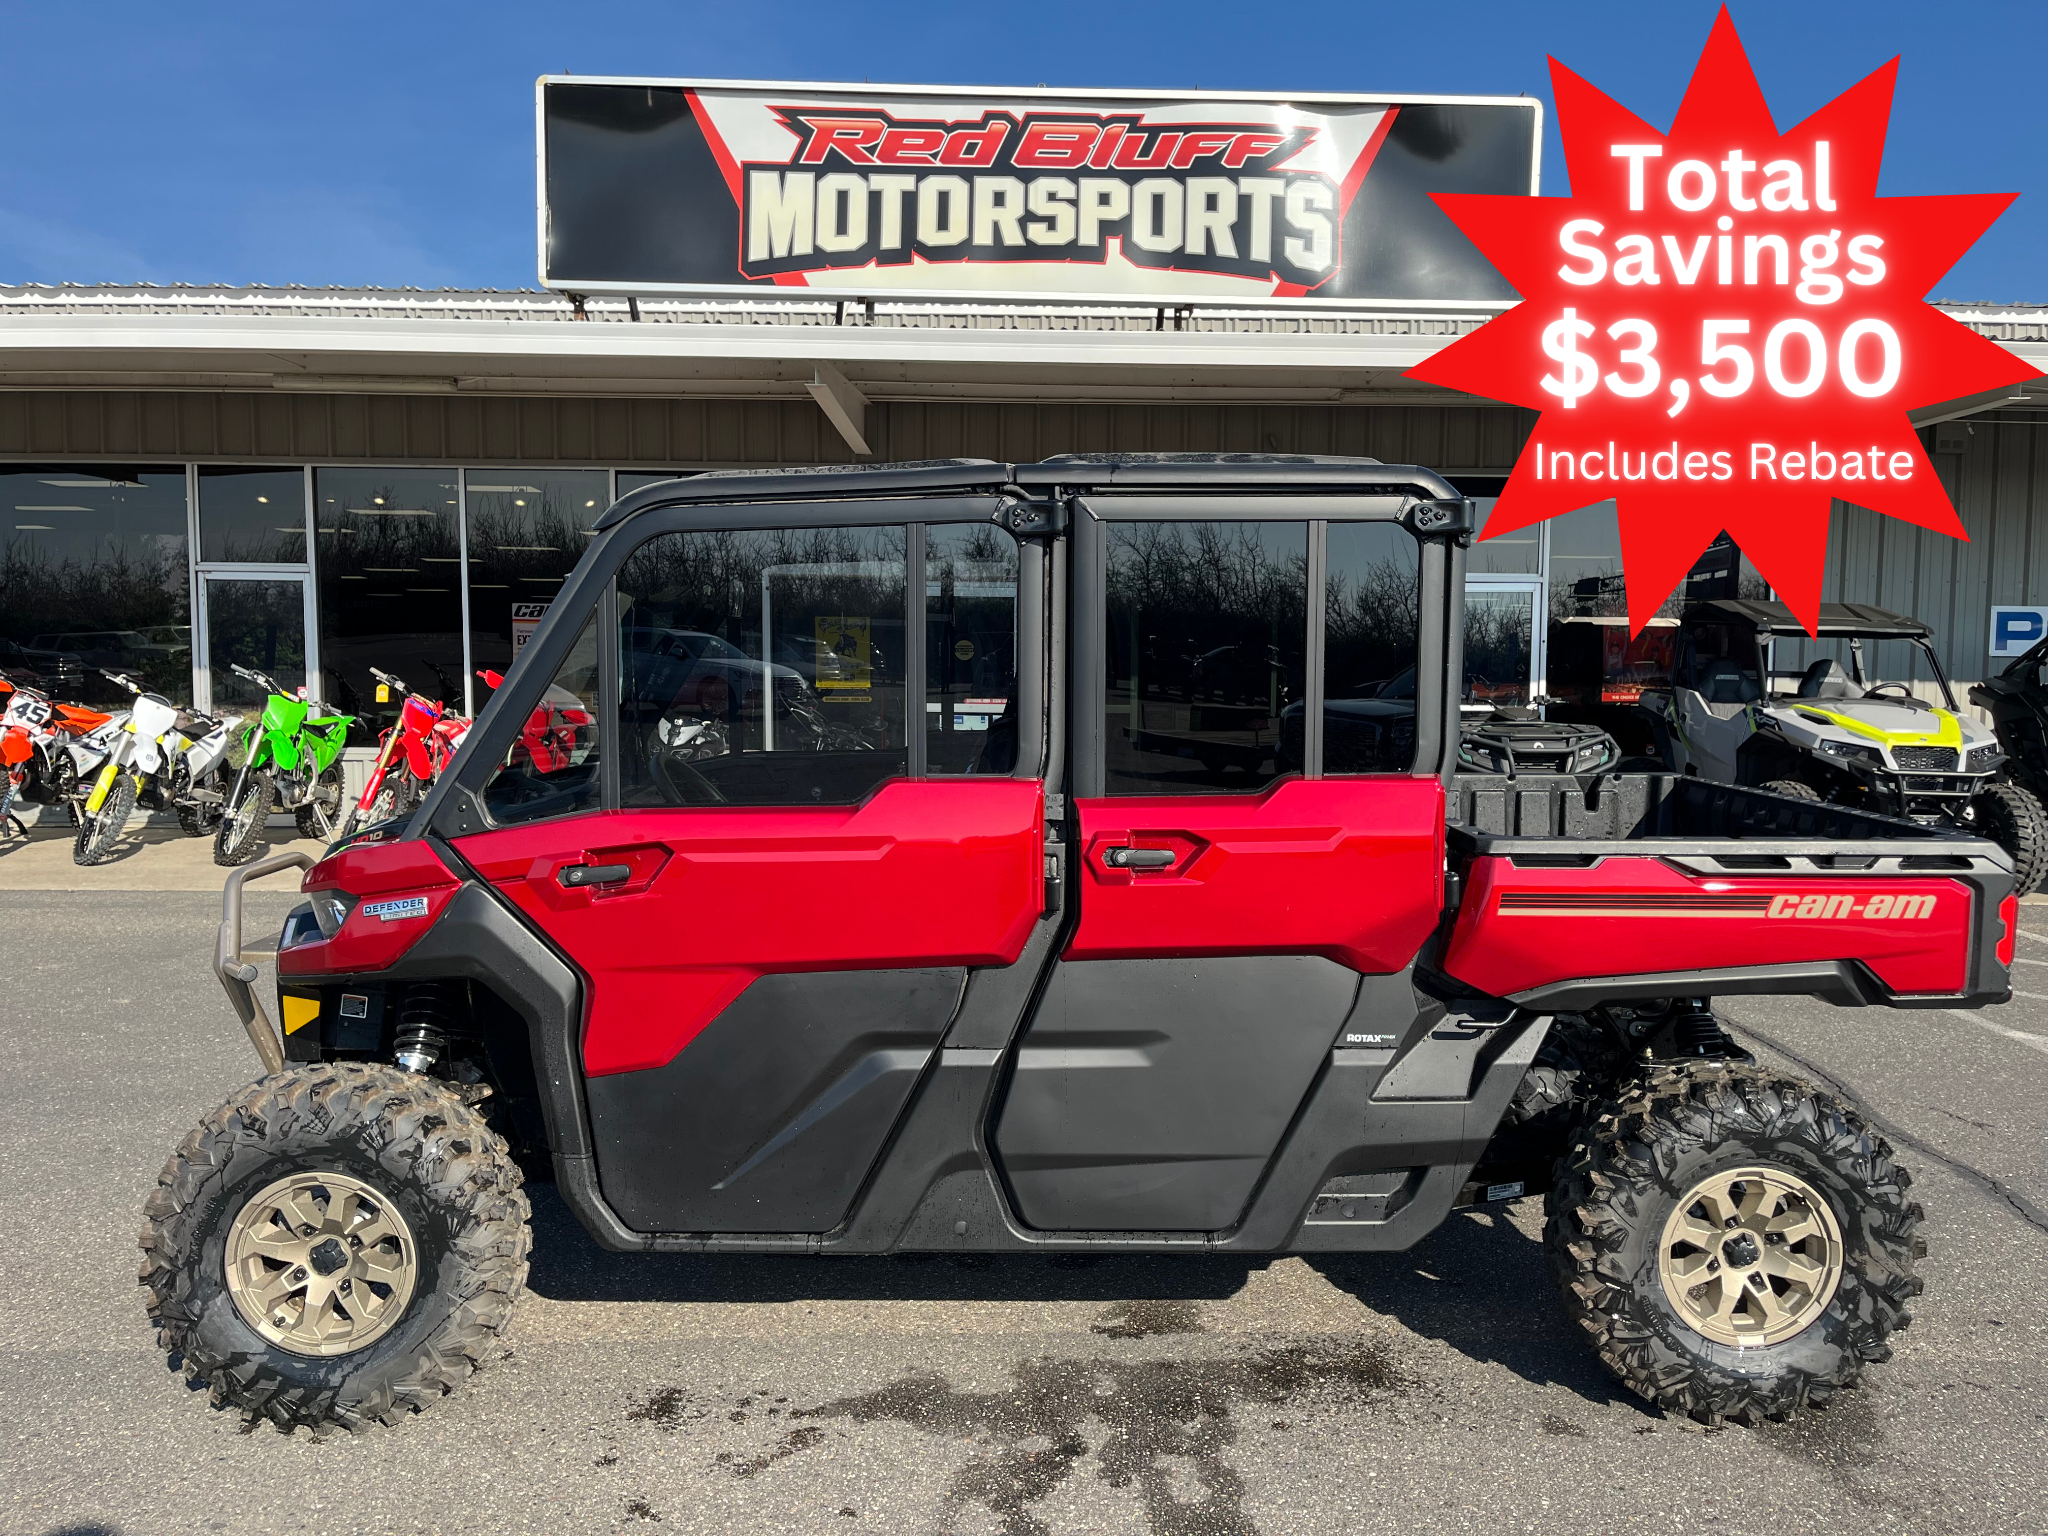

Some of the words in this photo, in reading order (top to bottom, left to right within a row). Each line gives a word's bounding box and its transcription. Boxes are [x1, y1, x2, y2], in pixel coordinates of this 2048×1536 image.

[798, 115, 1012, 169] Red
[747, 169, 1333, 274] MOTORSPORTS
[1995, 611, 2048, 650] P
[14, 701, 48, 724] 45
[364, 898, 424, 914] DEFENDER
[1765, 894, 1938, 920] can-am
[1346, 1033, 1382, 1043] ROTAX
